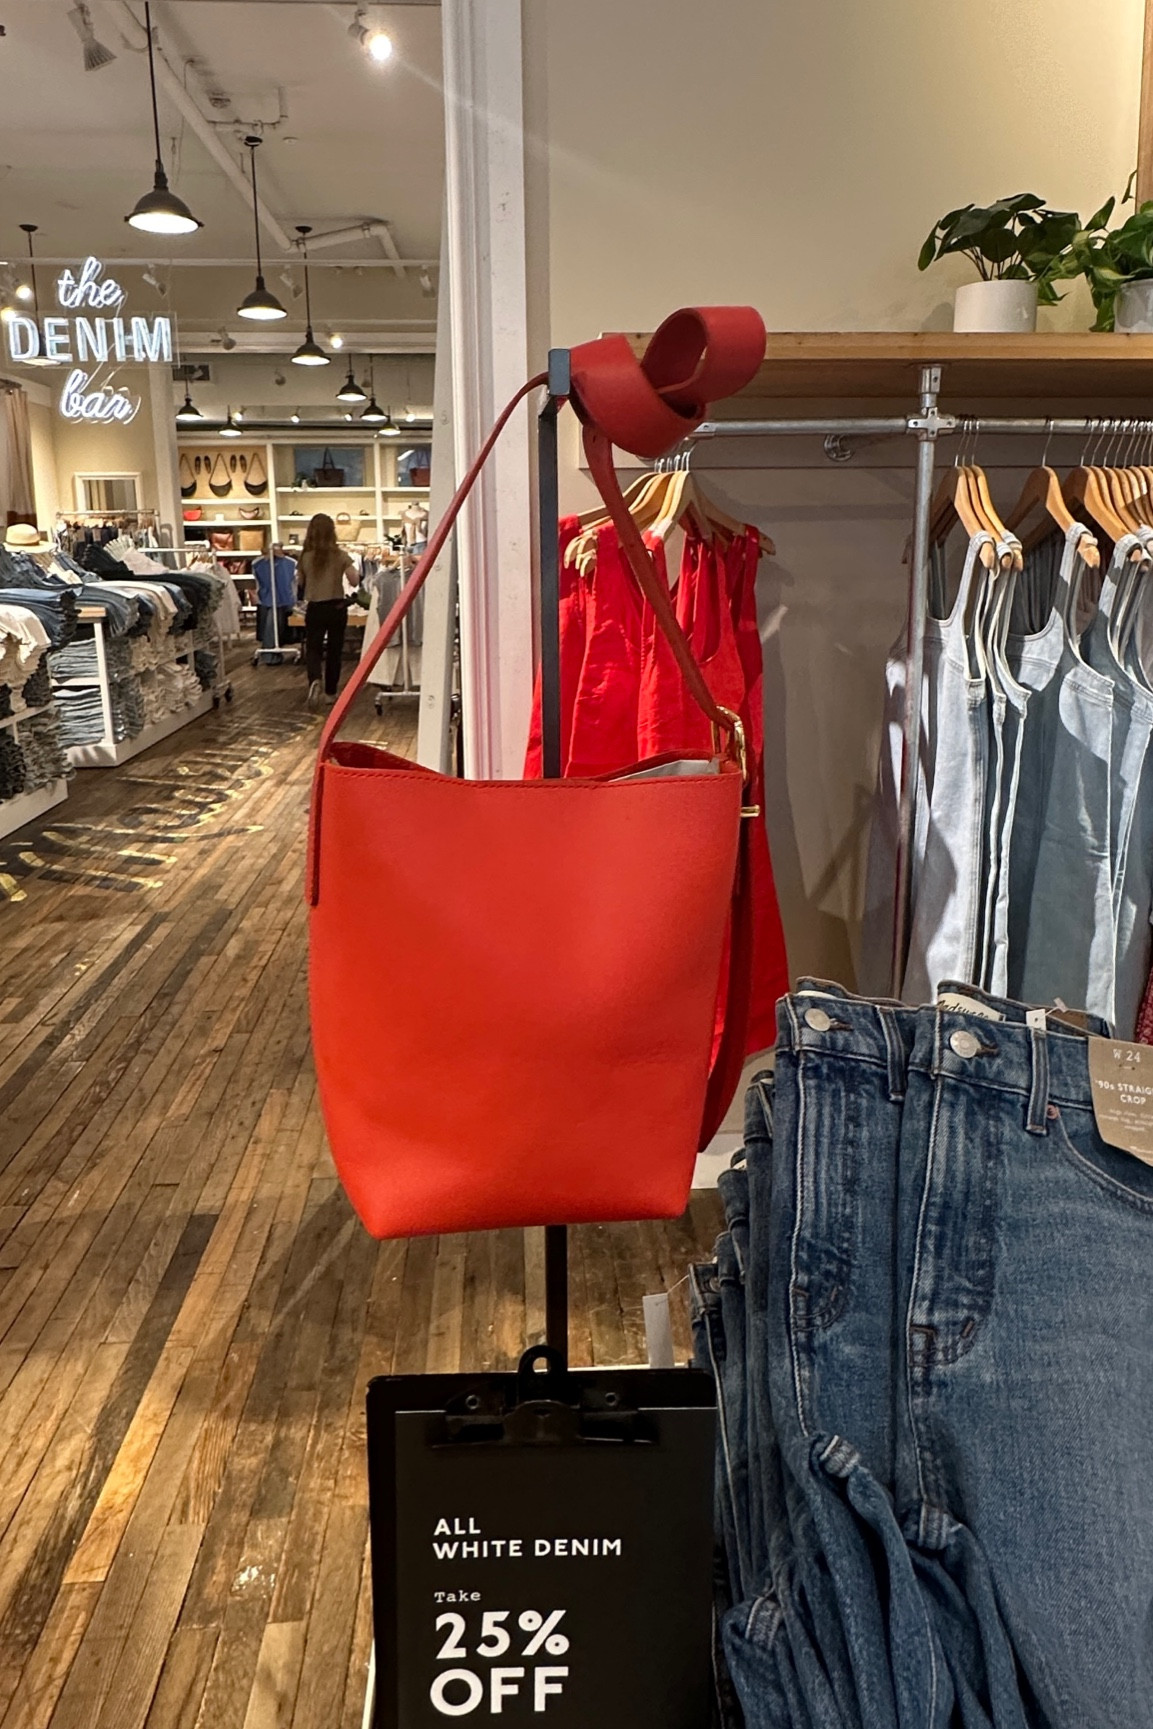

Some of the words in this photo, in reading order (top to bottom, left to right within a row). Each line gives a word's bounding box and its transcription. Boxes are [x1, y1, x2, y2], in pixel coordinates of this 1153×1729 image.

[57, 255, 125, 308] the
[8, 316, 173, 362] DENIM
[61, 368, 134, 419] bar
[1112, 1048, 1122, 1060] W
[1126, 1050, 1141, 1063] 24
[1117, 1082, 1153, 1096] STRAIG
[1120, 1094, 1147, 1105] CROP
[433, 1517, 482, 1536] ALL
[432, 1539, 523, 1560] WHITE
[534, 1538, 622, 1557] DENIM
[433, 1589, 482, 1604] Take
[435, 1609, 570, 1660] 25%
[429, 1665, 569, 1717] OFF
